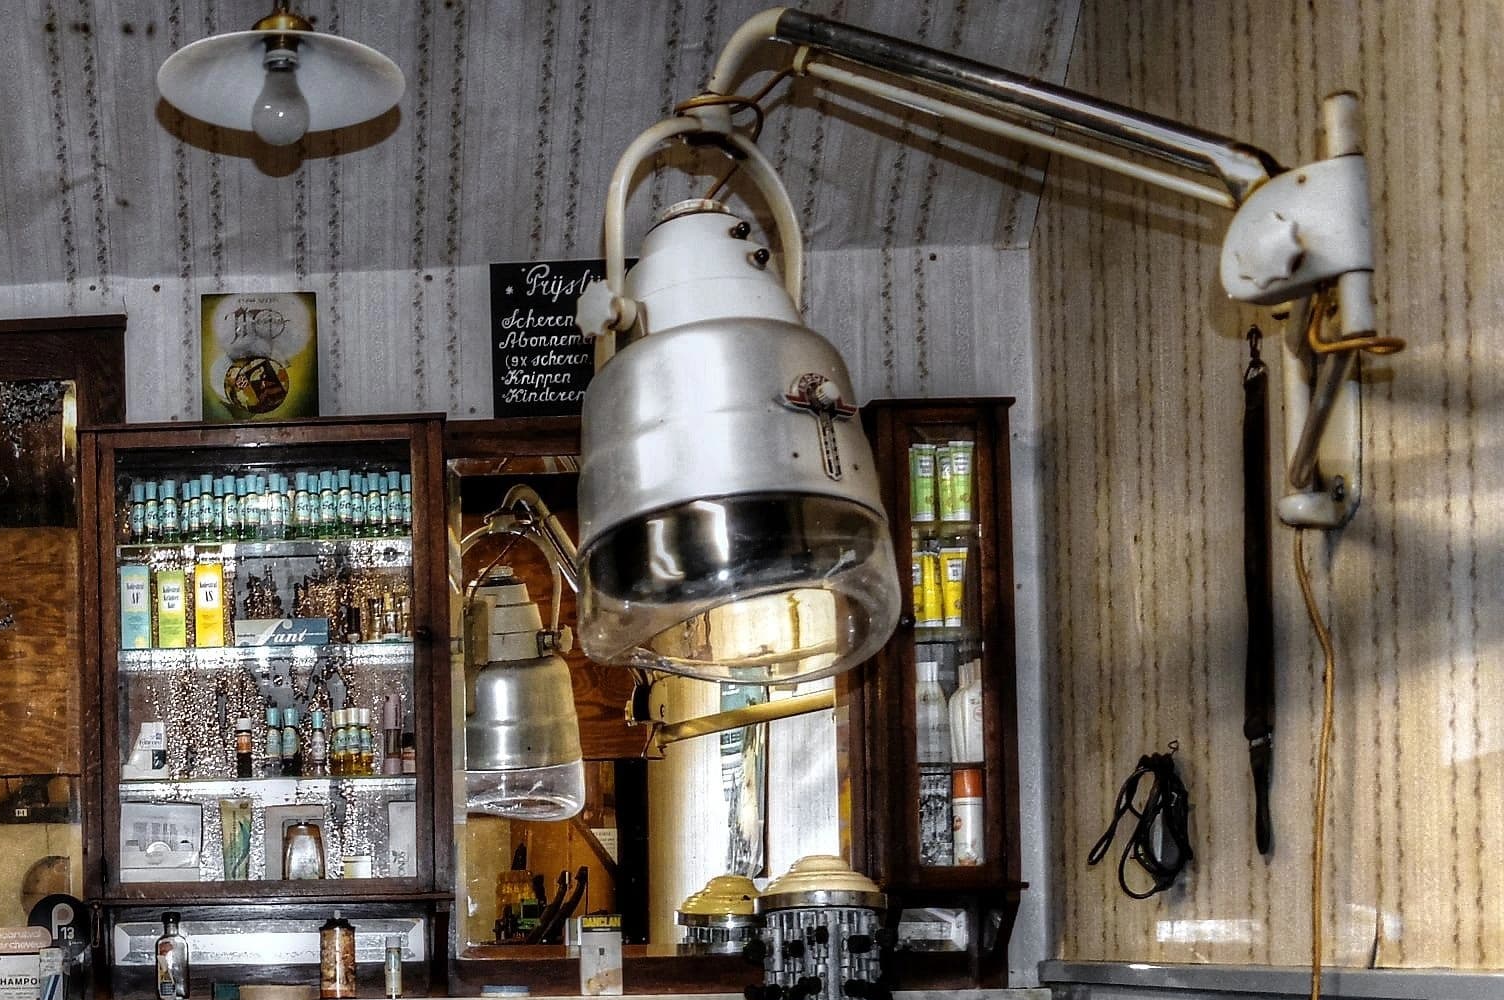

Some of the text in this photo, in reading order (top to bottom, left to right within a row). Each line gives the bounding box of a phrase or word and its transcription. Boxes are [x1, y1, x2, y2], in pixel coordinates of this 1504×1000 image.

[525, 263, 601, 302] Prijsl
[501, 308, 574, 329] Scheren
[501, 368, 572, 388] Knippen
[502, 387, 586, 404] Kinderen
